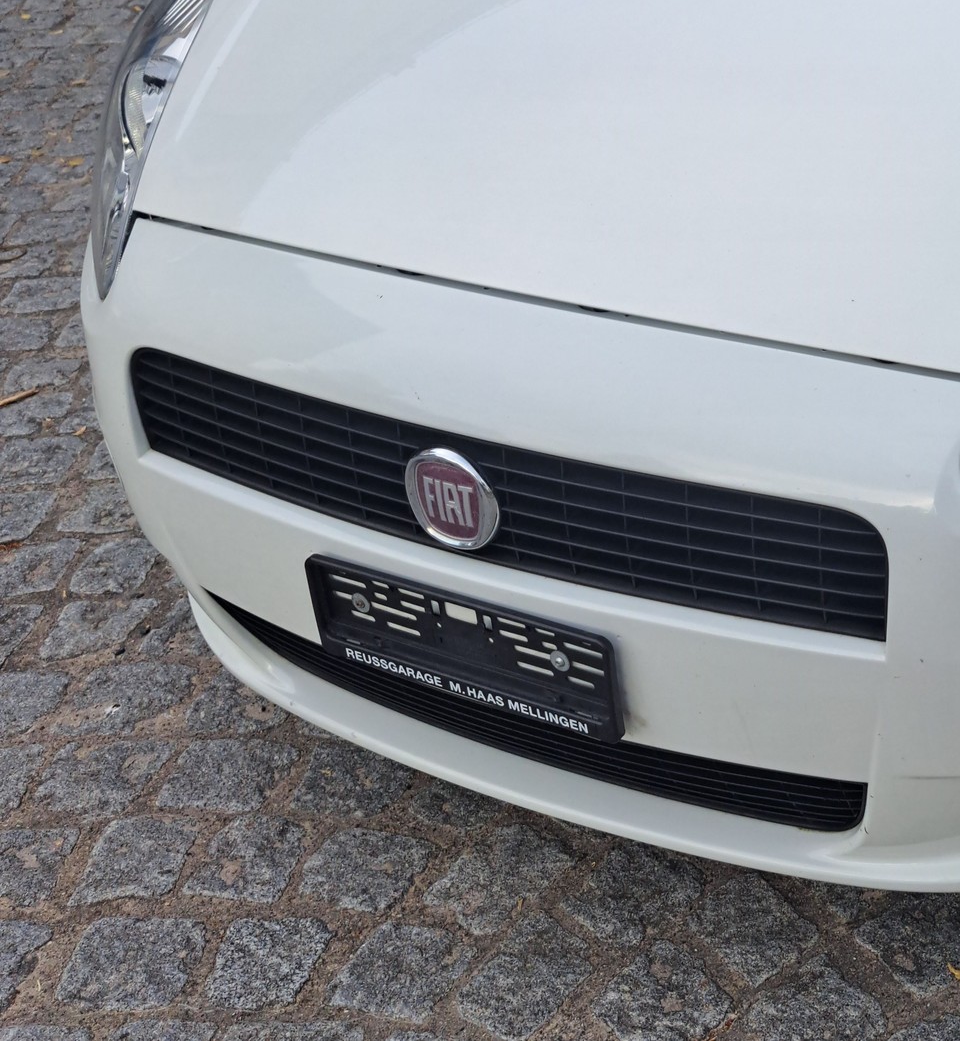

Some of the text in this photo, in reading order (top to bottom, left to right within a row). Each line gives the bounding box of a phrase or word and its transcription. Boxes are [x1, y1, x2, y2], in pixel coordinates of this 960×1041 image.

[422, 475, 474, 528] FIAT
[346, 648, 442, 687] REUSSGARAGE
[467, 686, 505, 707] HAAS
[507, 699, 589, 734] MELLINGEN
